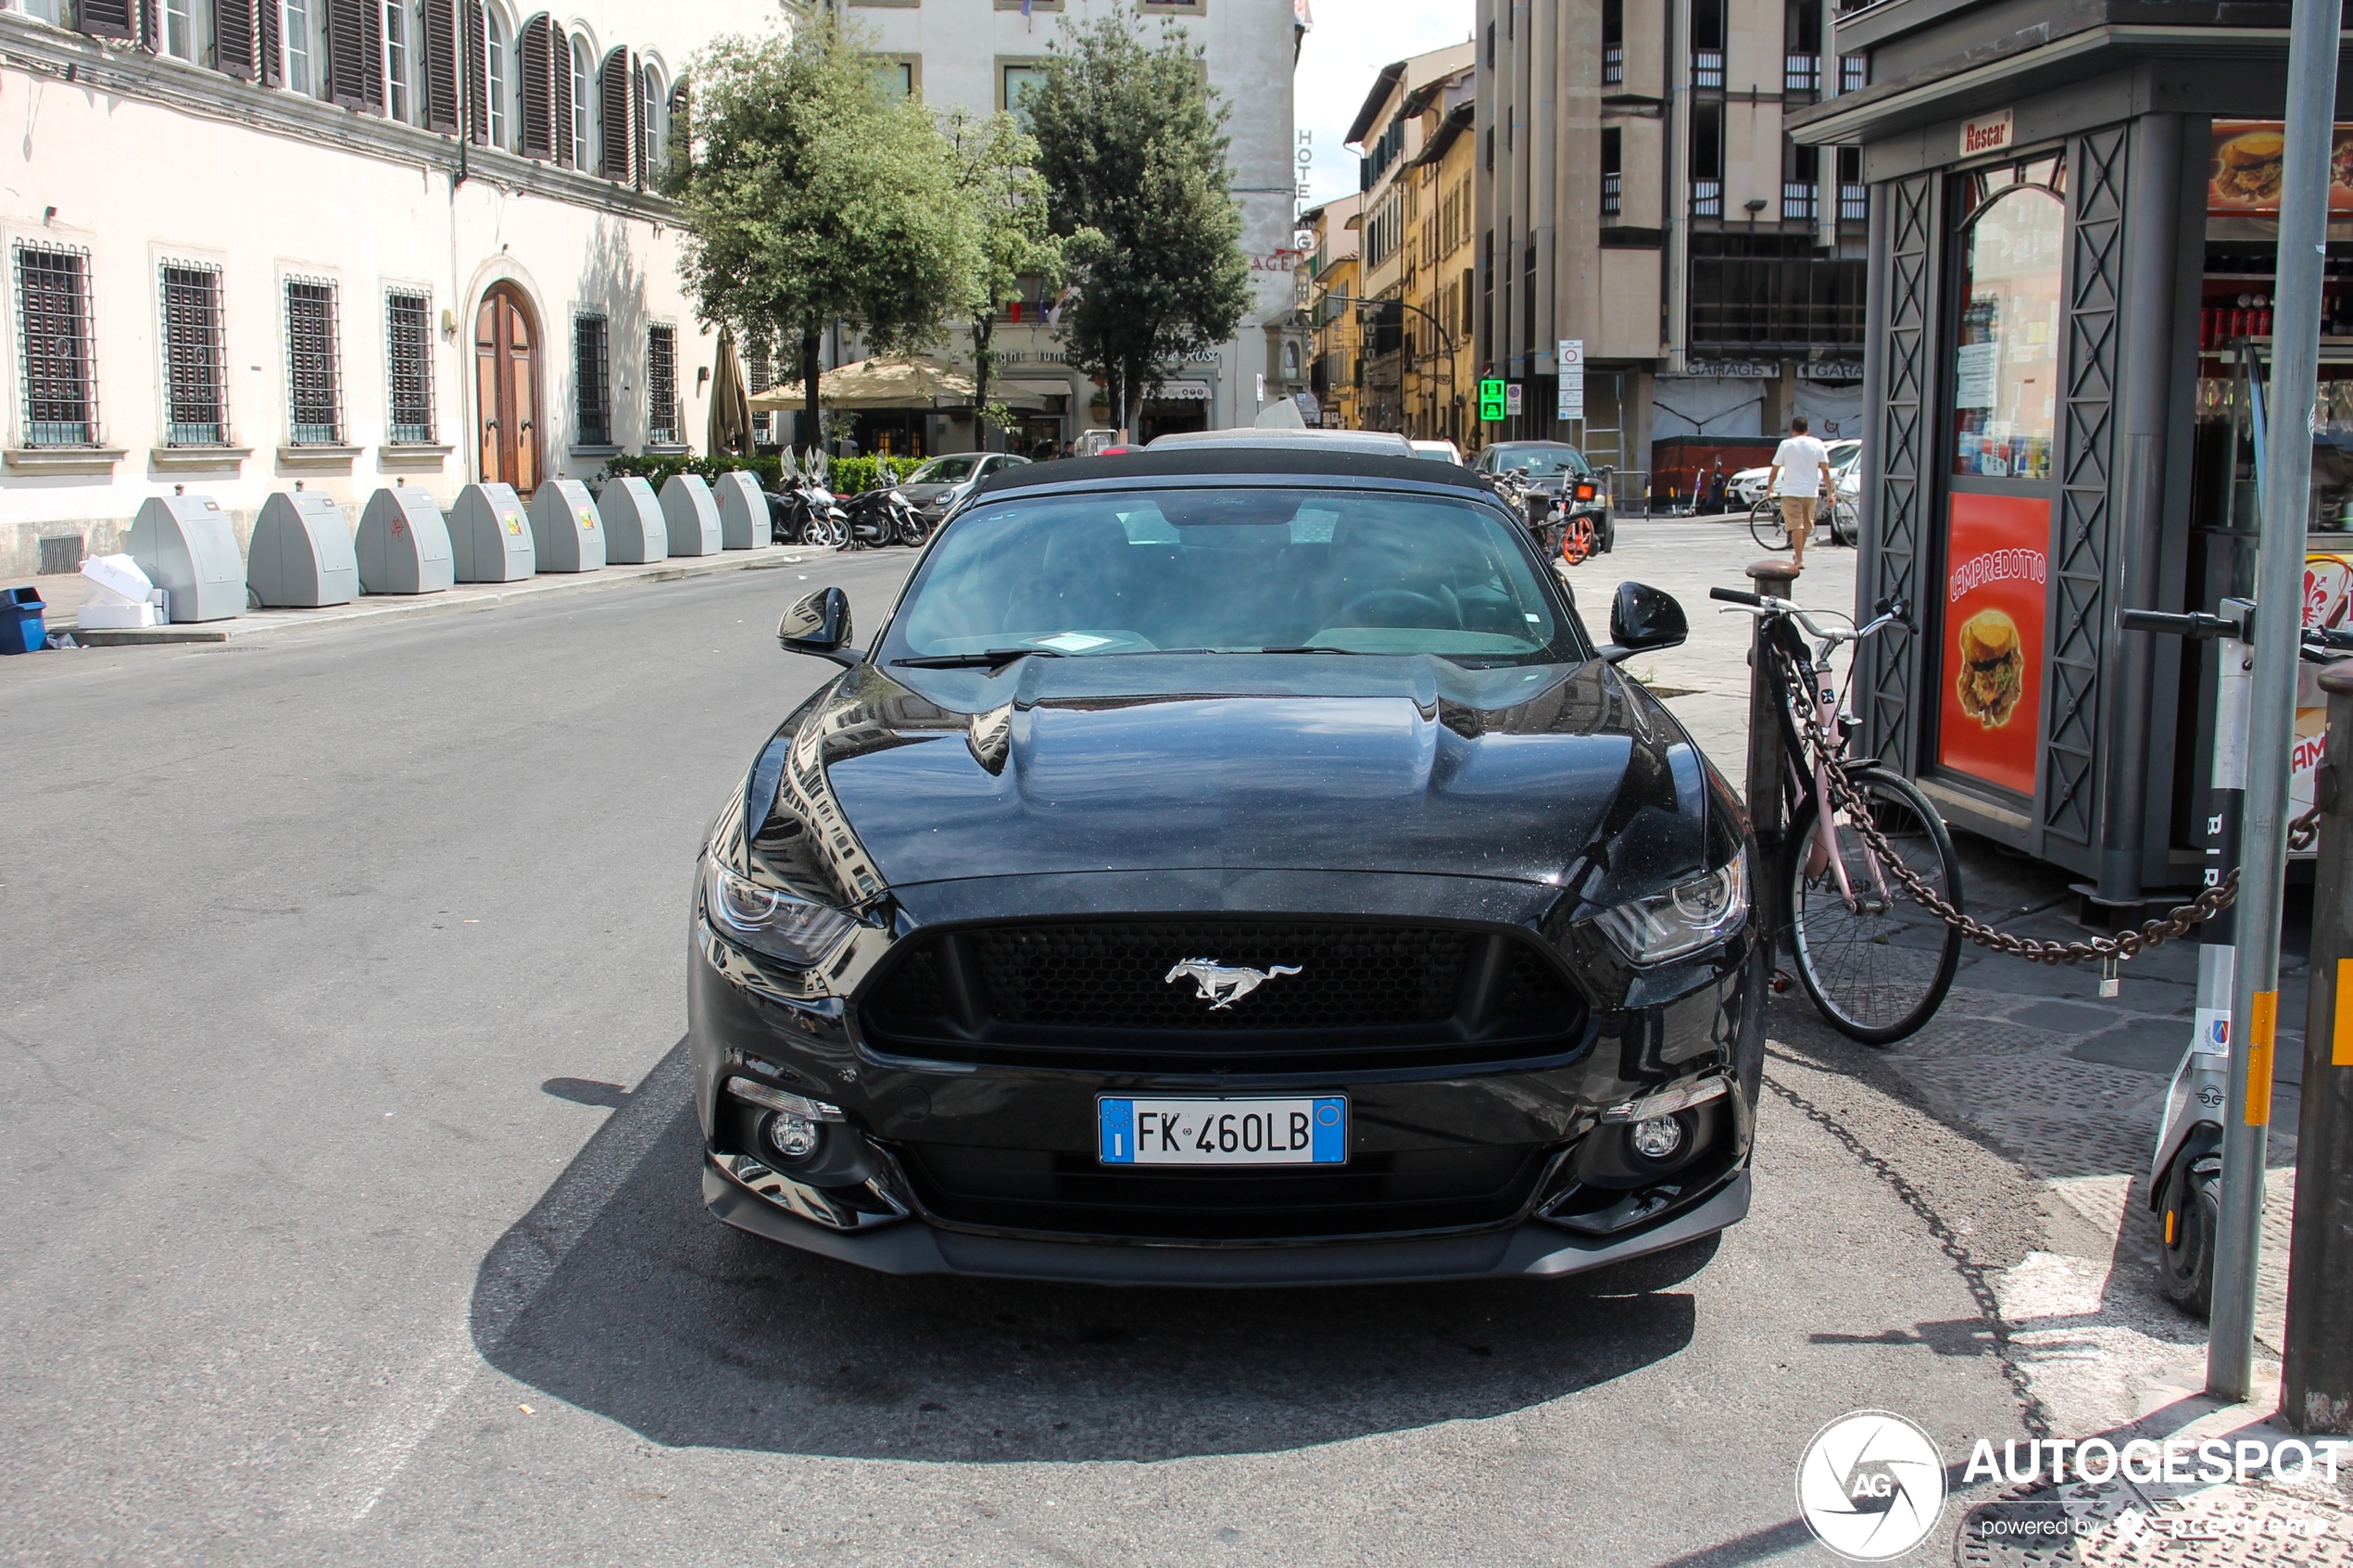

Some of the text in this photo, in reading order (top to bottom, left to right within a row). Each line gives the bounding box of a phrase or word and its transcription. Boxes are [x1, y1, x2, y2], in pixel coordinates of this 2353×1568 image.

[1966, 123, 2006, 152] Rescar
[1297, 130, 1312, 217] HOTEL
[1251, 255, 1290, 271] AGE
[1365, 315, 1376, 359] OTO
[1686, 363, 1764, 376] GARAGE
[1815, 364, 1864, 377] GARA
[1950, 548, 2046, 602] LAMPREDOTTO
[2204, 813, 2222, 920] BIR
